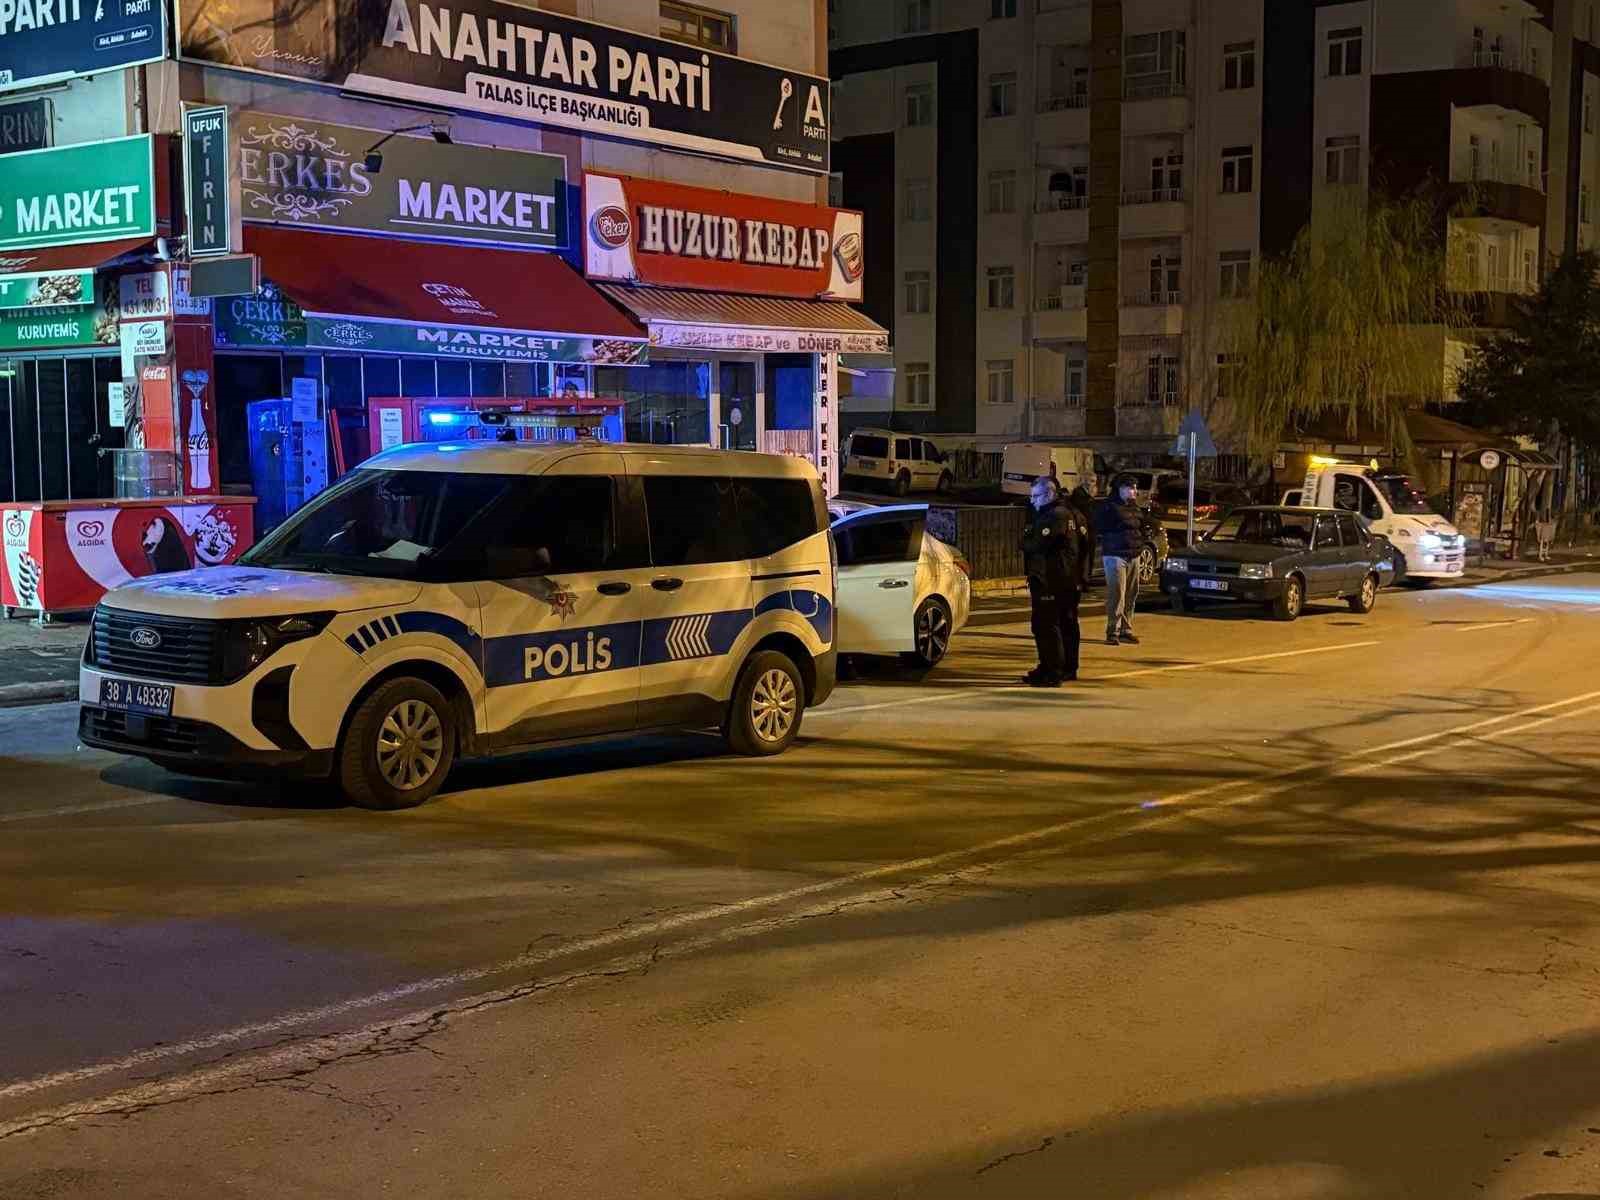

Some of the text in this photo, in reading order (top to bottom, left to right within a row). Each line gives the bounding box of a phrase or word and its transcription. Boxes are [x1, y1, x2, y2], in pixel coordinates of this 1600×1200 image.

[382, 0, 710, 112] ANAHTAR PARTİ
[475, 81, 641, 127] TALAS İLÇE BAŞKANLIĞI
[804, 85, 825, 127] A
[192, 117, 221, 133] UFUK
[202, 135, 216, 244] FIRIN
[399, 179, 555, 230] MARKET
[16, 185, 140, 233] MARKET
[642, 206, 830, 269] HUZUR KEBAP
[232, 300, 303, 325] ÇERKE
[17, 319, 80, 341] KURUYEMİŞ
[416, 328, 565, 350] MARKET
[798, 333, 841, 351] DÖNER
[437, 344, 551, 360] KURUYEMİŞ
[135, 629, 157, 646] Ford
[524, 631, 613, 679] POLİS
[106, 681, 169, 708] 38 A 48332
